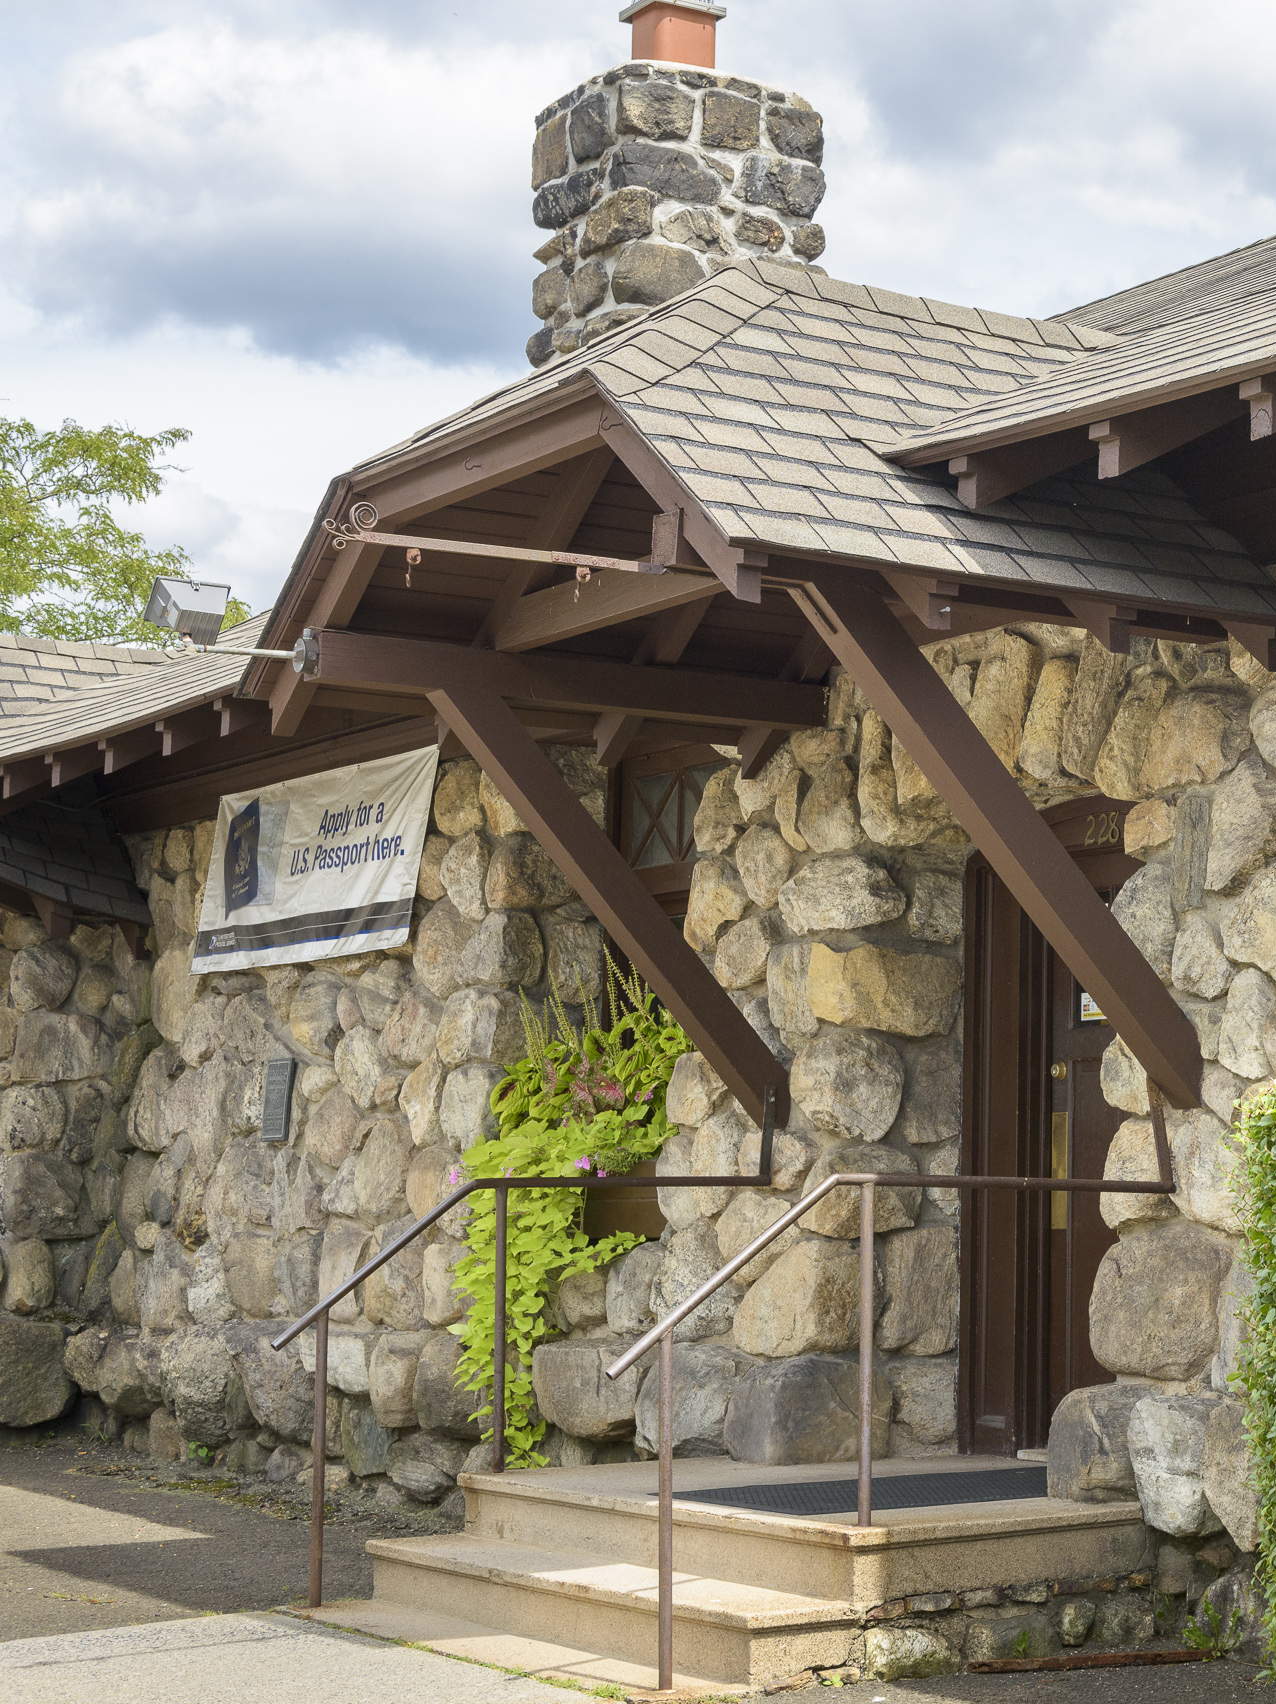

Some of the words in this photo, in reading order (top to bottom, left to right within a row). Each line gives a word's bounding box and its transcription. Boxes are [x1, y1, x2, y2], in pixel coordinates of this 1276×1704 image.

[317, 804, 354, 840] Apply
[355, 800, 373, 828] for
[375, 802, 385, 824] a
[1084, 811, 1120, 846] 228
[290, 847, 310, 877] U.S.
[311, 835, 371, 873] Passport
[371, 834, 405, 861] here.
